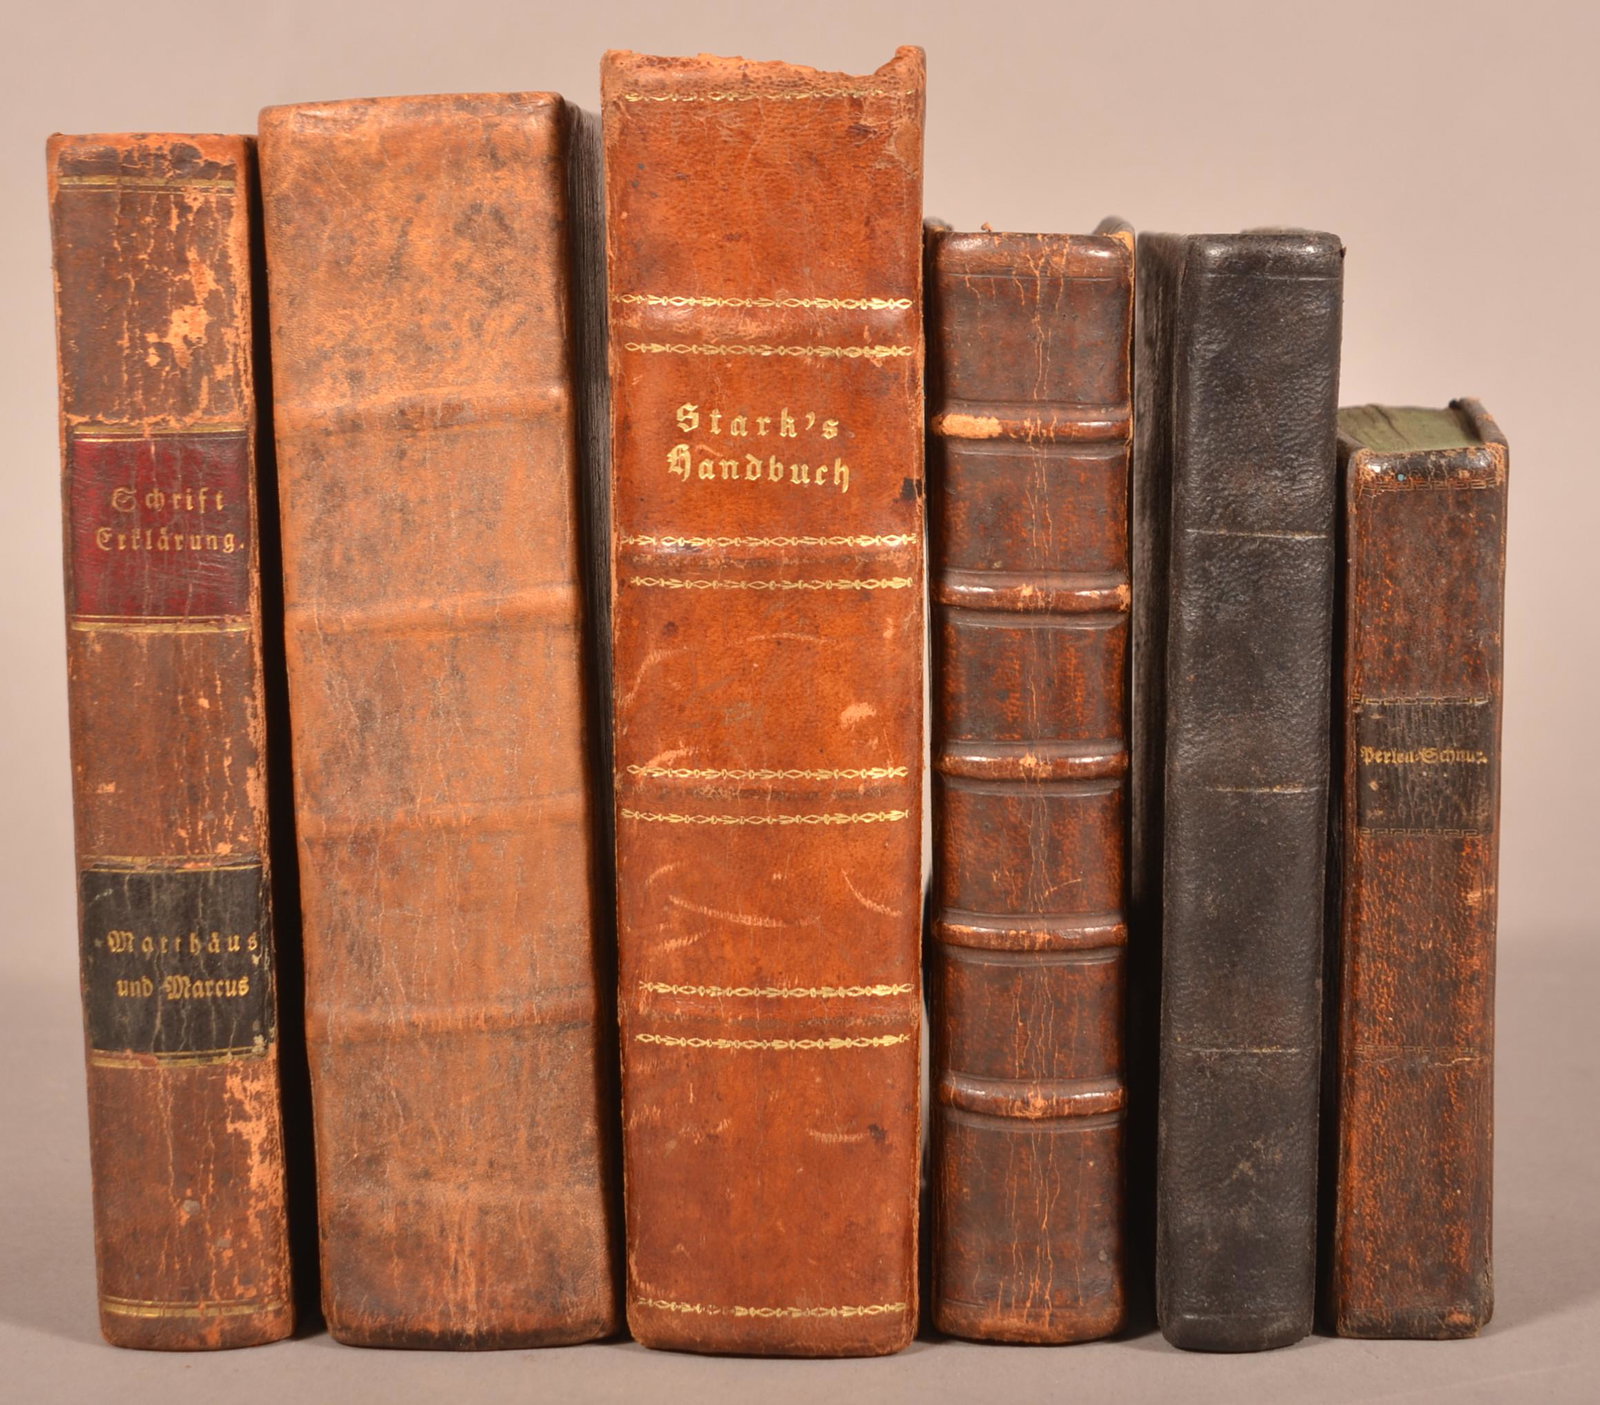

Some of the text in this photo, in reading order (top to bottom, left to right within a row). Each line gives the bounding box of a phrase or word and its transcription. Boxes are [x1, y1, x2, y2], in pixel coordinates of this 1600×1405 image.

[676, 402, 840, 440] Stark's
[666, 443, 851, 494] Handbuch
[111, 486, 225, 514] Schrift
[106, 929, 259, 957] Matthäus
[116, 974, 251, 1000] und Marcus
